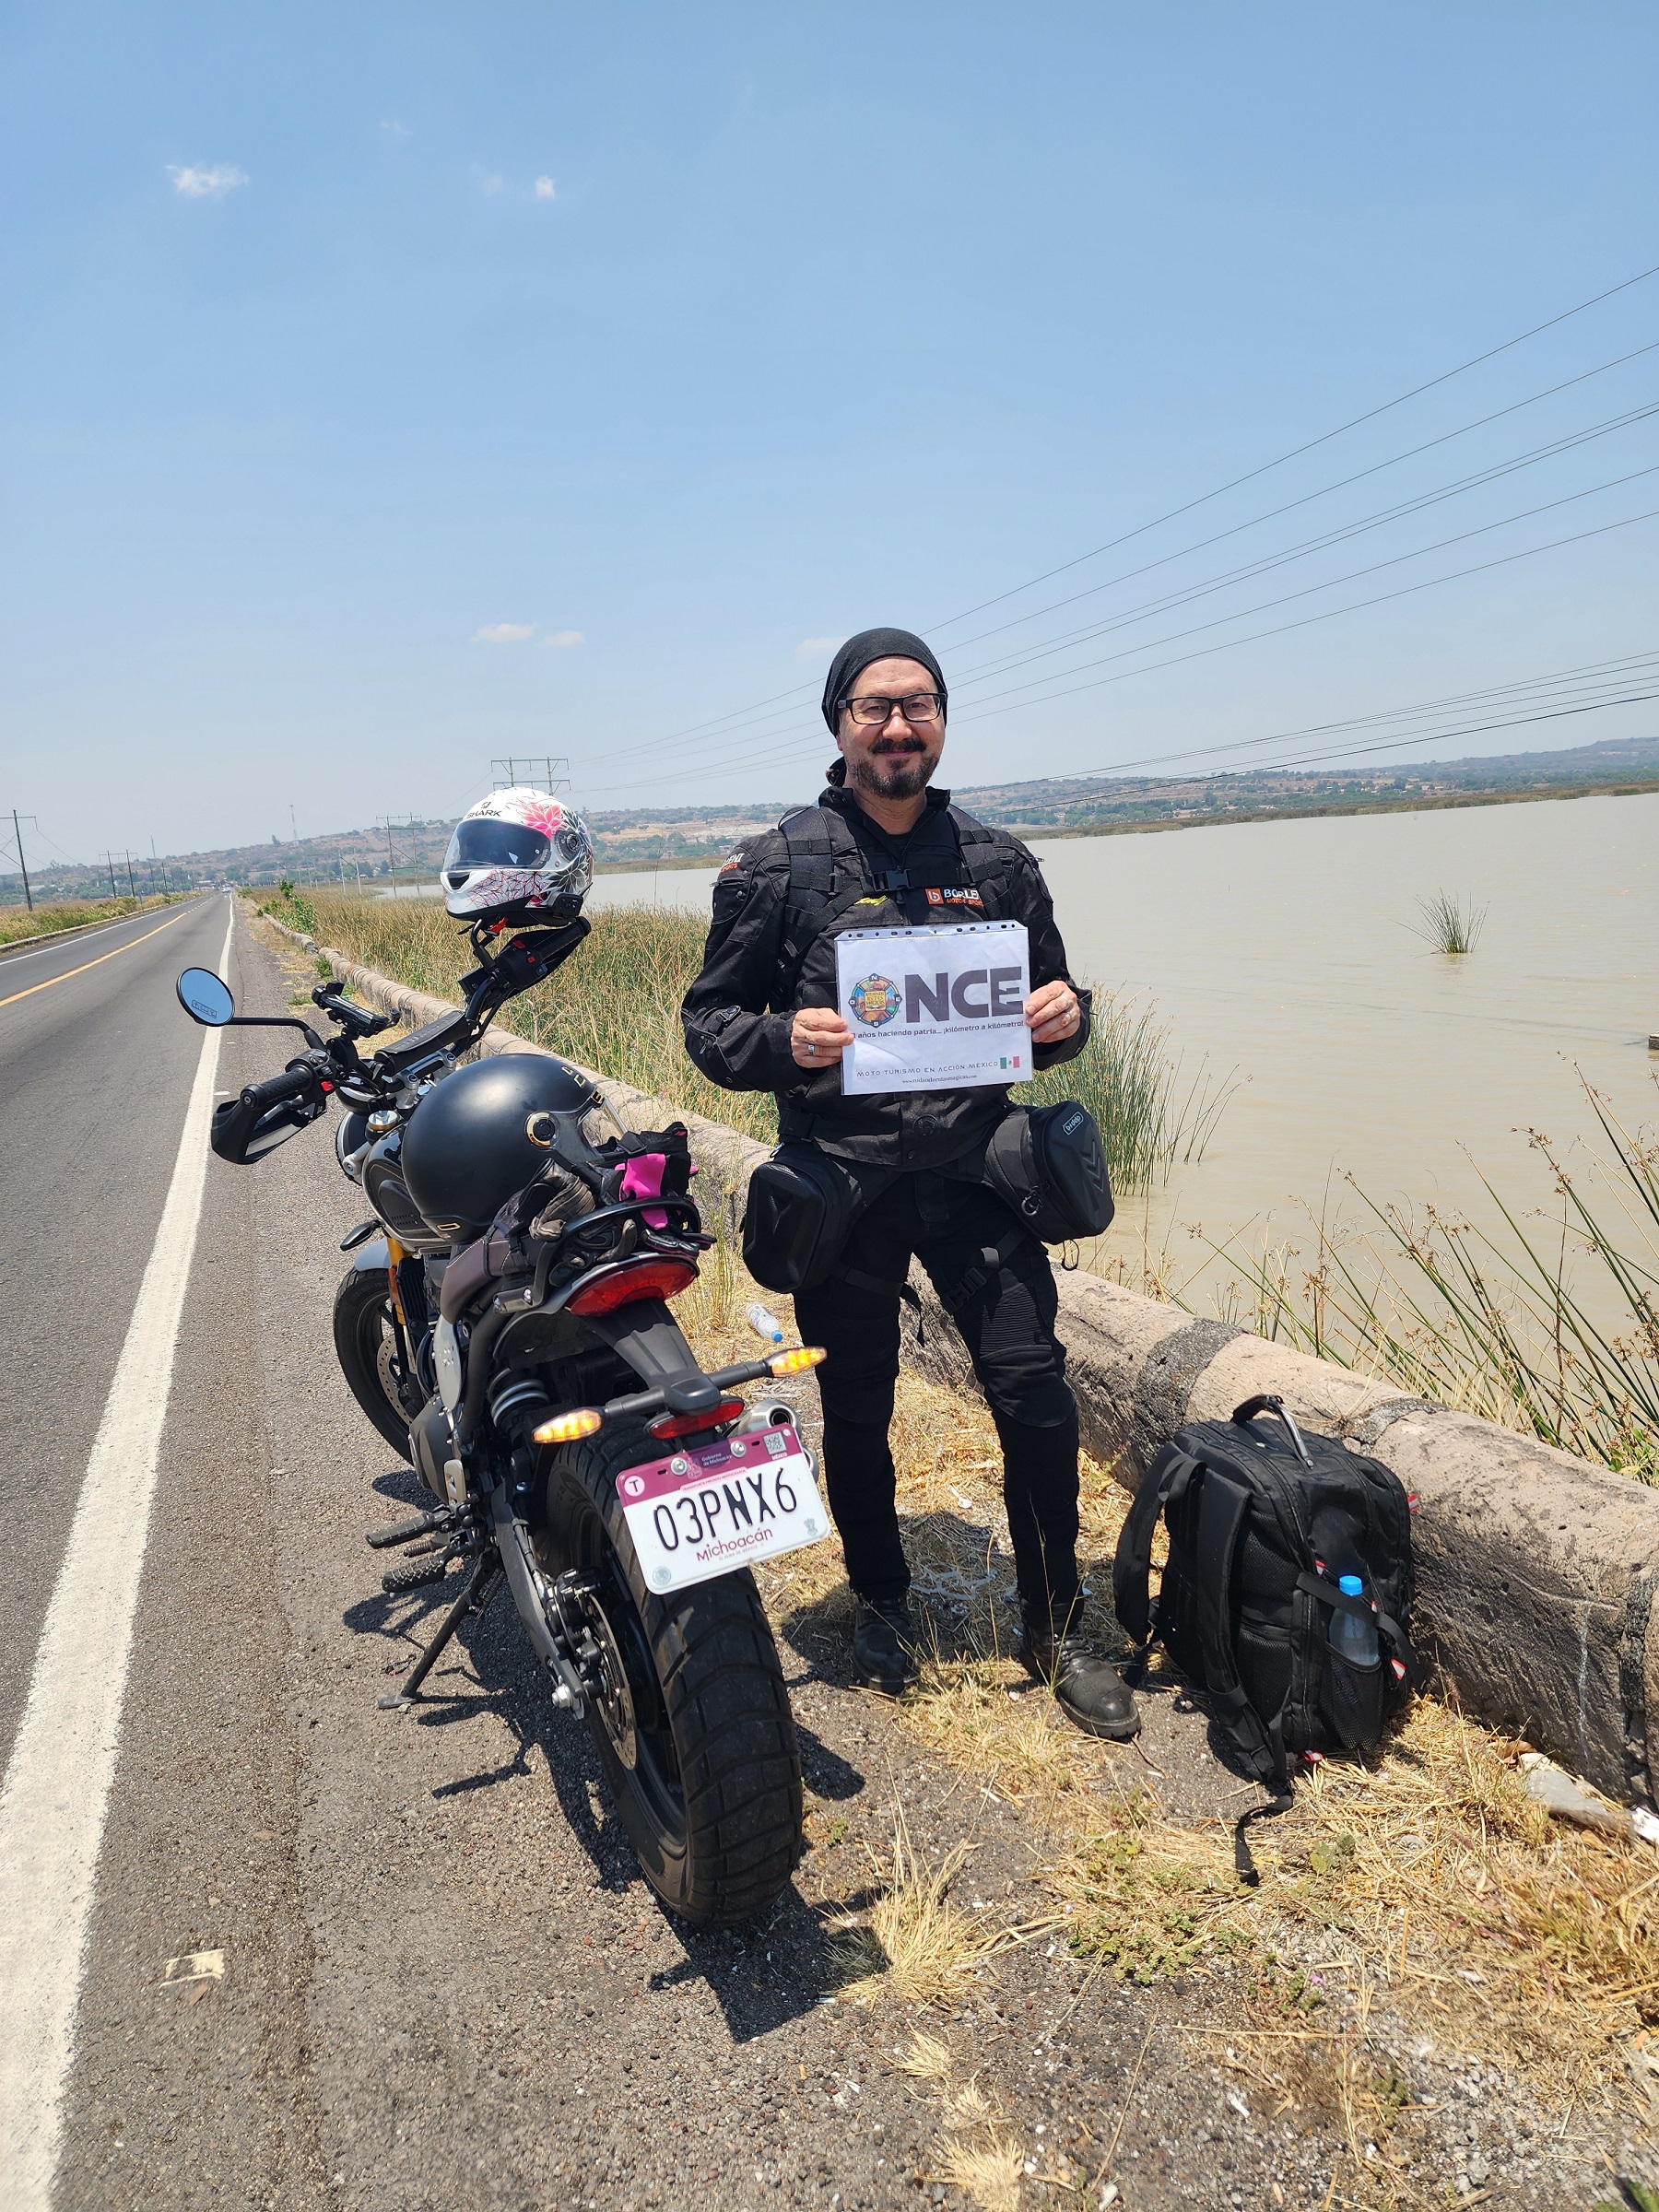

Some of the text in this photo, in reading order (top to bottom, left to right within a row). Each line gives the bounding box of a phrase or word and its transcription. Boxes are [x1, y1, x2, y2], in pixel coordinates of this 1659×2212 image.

[465, 809, 502, 818] SHARK
[944, 888, 981, 900] BORLE
[987, 1020, 1024, 1030] kilómetro!
[884, 1067, 921, 1076] TURISMO
[700, 1453, 722, 1462] Gobierno
[629, 1478, 640, 1493] T
[653, 1466, 797, 1551] 03PNX6
[696, 1527, 773, 1561] Michoacán
